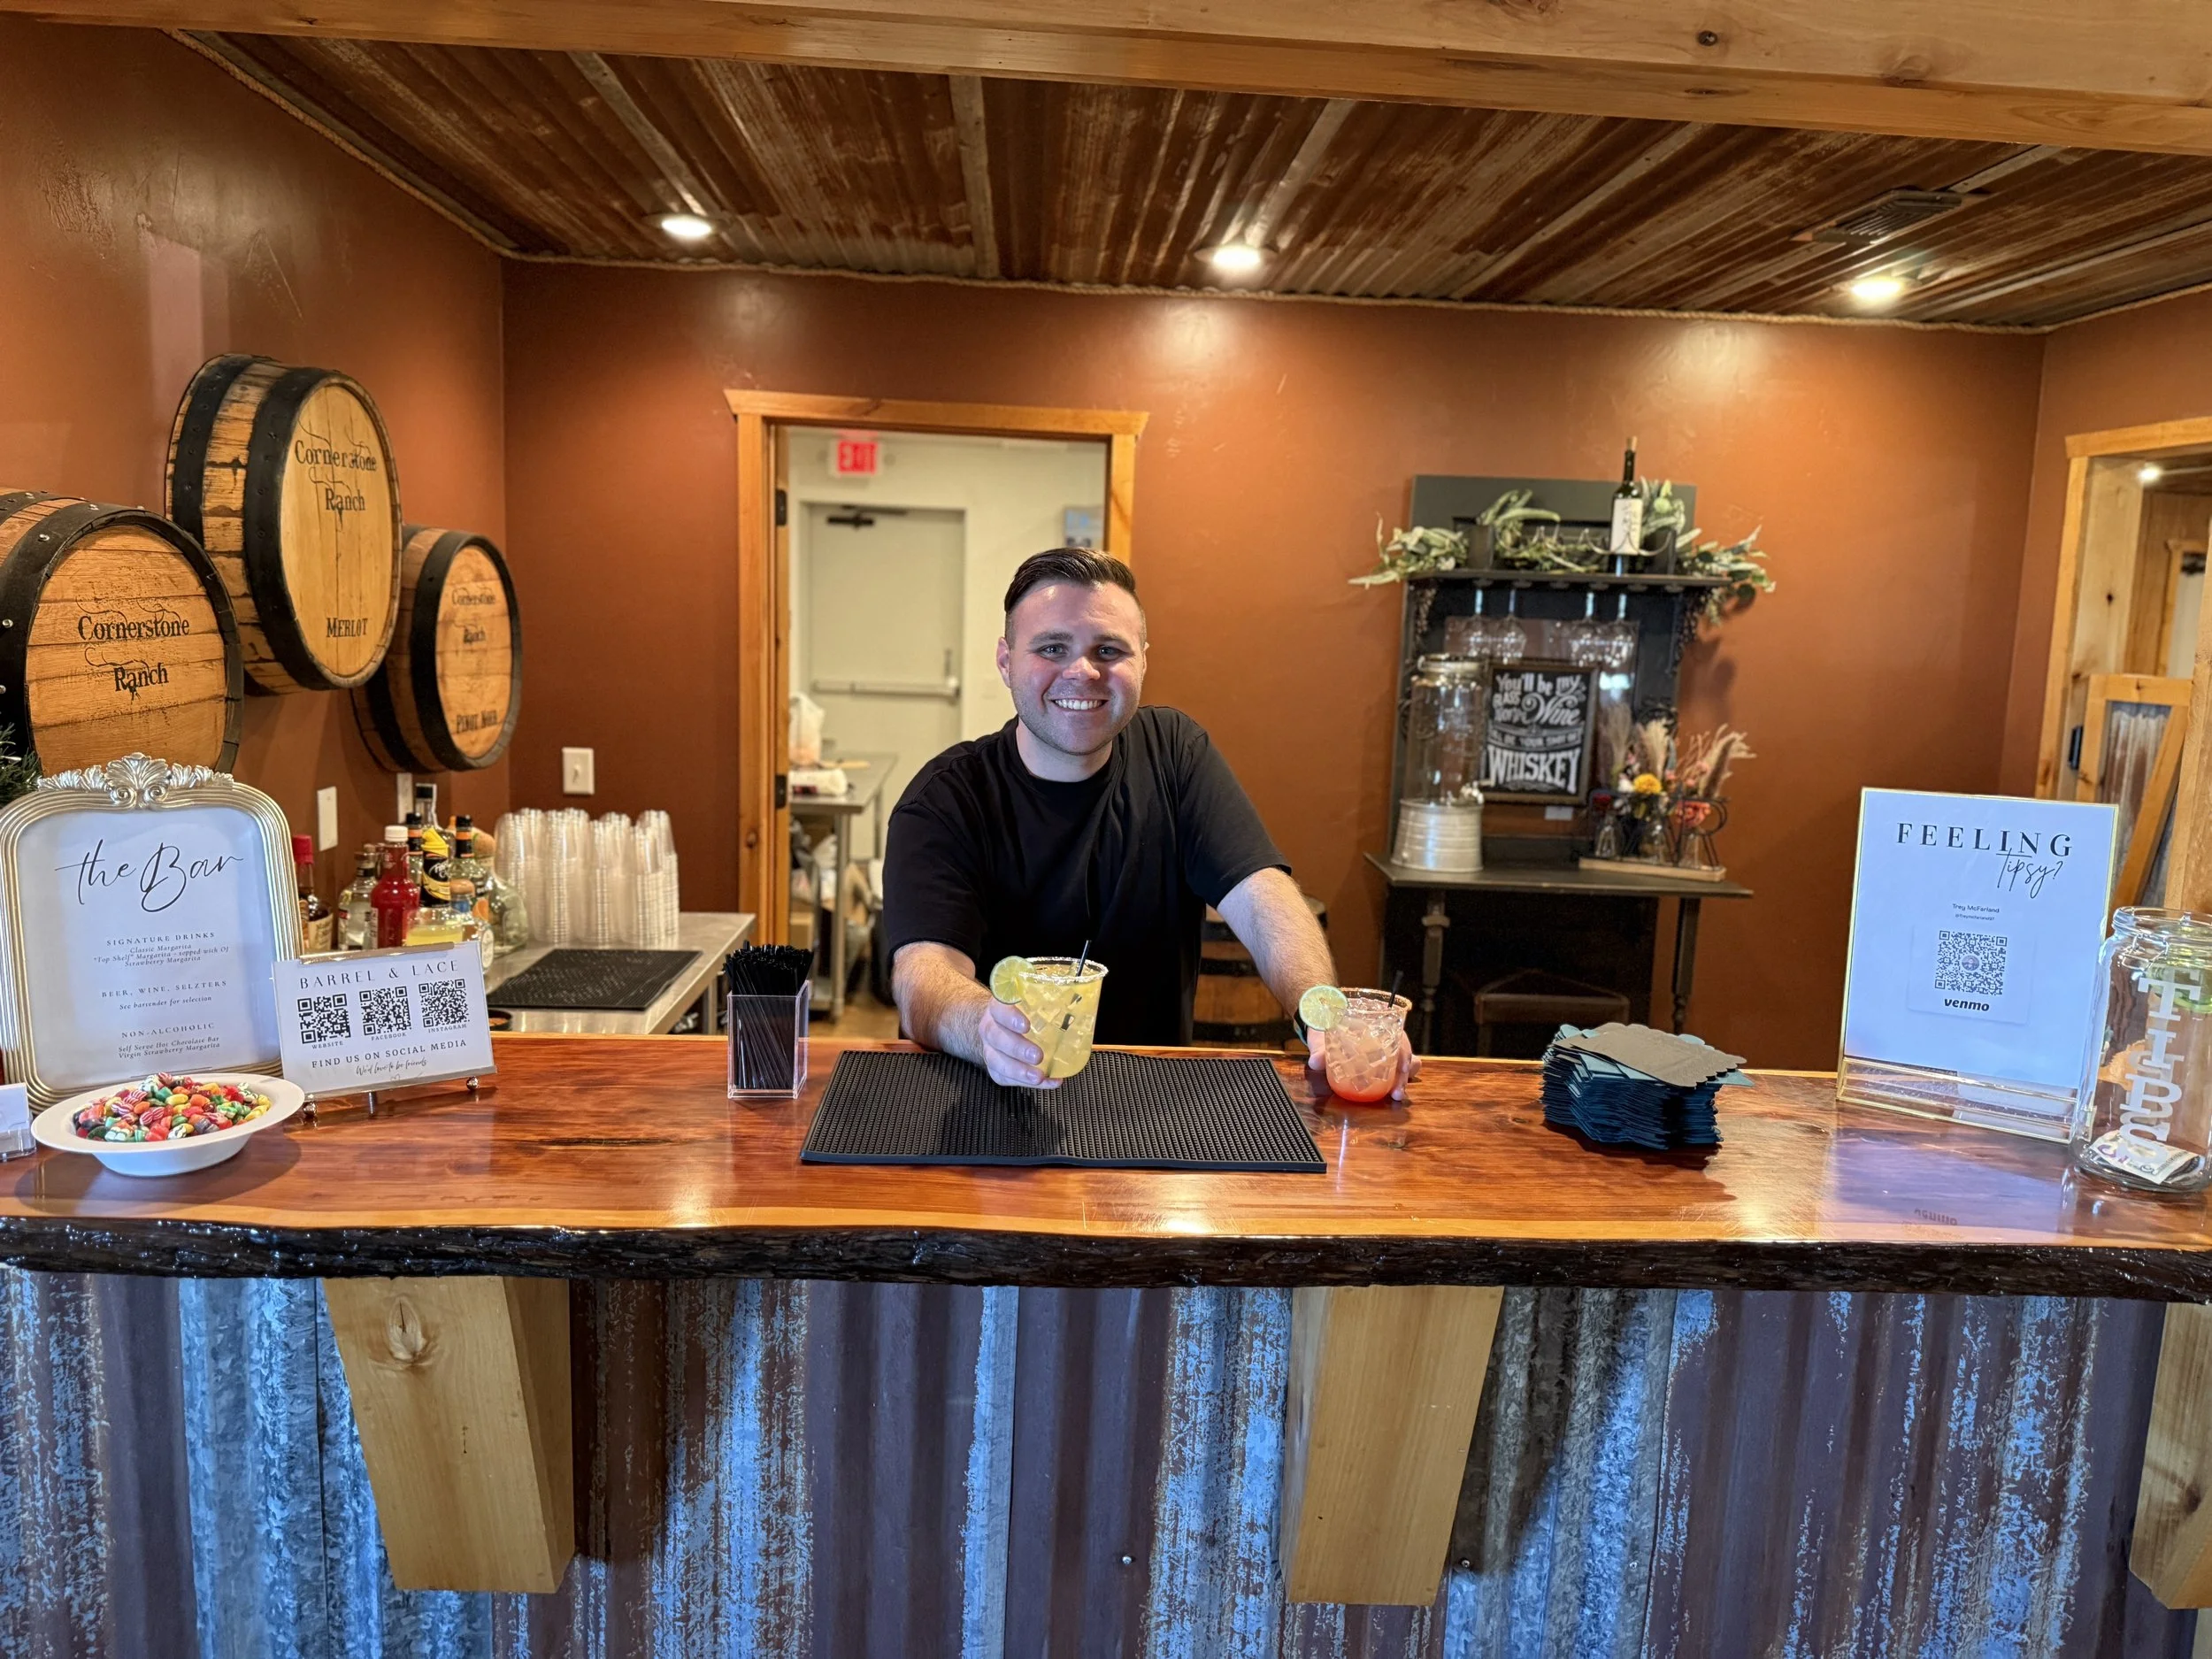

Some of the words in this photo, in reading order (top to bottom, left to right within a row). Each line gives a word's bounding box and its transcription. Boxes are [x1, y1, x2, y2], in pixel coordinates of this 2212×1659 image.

[295, 440, 377, 471] Cornerstone
[838, 441, 877, 474] EXIT
[325, 488, 365, 511] Ranch
[78, 615, 190, 641] Cornerstone
[113, 662, 169, 692] Ranch
[1522, 692, 1581, 726] Wine
[1487, 744, 1582, 794] WHISKEY
[1896, 822, 2073, 857] FEELING
[54, 839, 137, 905] the
[140, 842, 244, 913] Bar
[1995, 848, 2063, 899] Tipsy?
[1967, 904, 2000, 914] McFarland
[106, 935, 170, 947] SIGNATURE
[175, 932, 216, 941] DRINKS
[157, 943, 192, 952] Margarita
[125, 958, 165, 967] Strawberry
[166, 956, 201, 964] Margarita
[136, 951, 172, 960] Margarita
[179, 949, 201, 958] topped
[299, 970, 375, 990] BARREL
[388, 967, 399, 979] &
[412, 960, 458, 977] LACE
[102, 989, 134, 998] BEER,
[175, 980, 227, 992] SELZTERS
[133, 1000, 167, 1009] bartender
[169, 997, 180, 1007] for
[182, 995, 212, 1004] selection
[1944, 998, 1990, 1011] venmo
[121, 1022, 215, 1039] NON-ALCOHOLIC
[311, 1040, 344, 1050] WEBSITE
[371, 1032, 407, 1041] FACEBOOK
[428, 1024, 467, 1033] INSTAGRAM
[119, 1044, 132, 1053] Self
[171, 1038, 205, 1047] Chocolate
[144, 1047, 183, 1056] Strawberry
[186, 1042, 220, 1051] Margarita
[311, 1056, 342, 1069] FIND
[346, 1054, 360, 1064] US
[365, 1051, 380, 1062] ON
[385, 1045, 426, 1058] SOCIAL
[430, 1039, 467, 1052] MEDIA
[405, 1056, 428, 1070] friends
